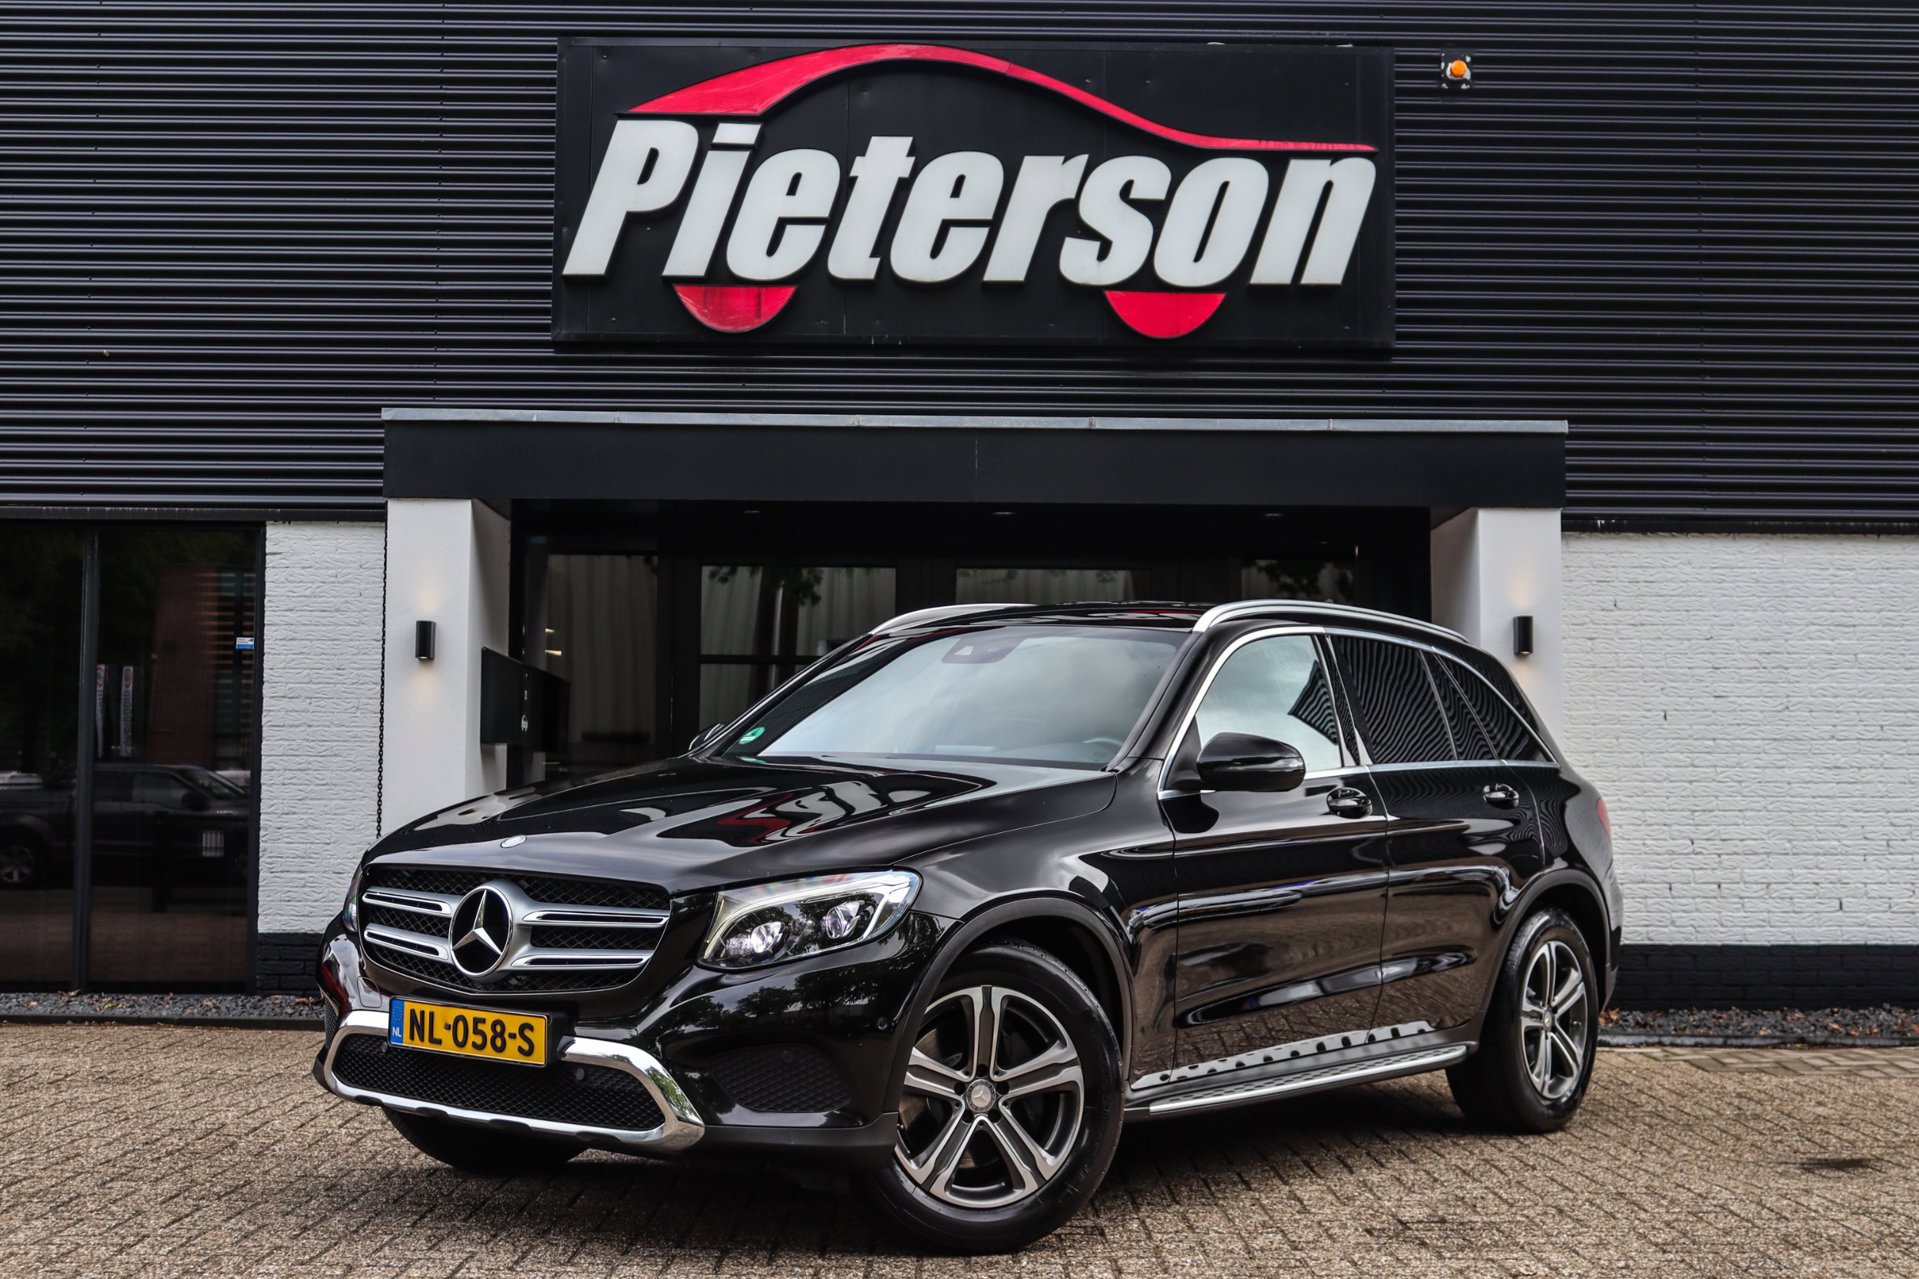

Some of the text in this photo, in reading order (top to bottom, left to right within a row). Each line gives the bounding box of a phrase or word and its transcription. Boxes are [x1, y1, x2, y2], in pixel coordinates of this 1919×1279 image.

[563, 120, 1376, 286] Pieterson
[392, 1027, 402, 1038] NL
[409, 1008, 535, 1057] NL-058-S
